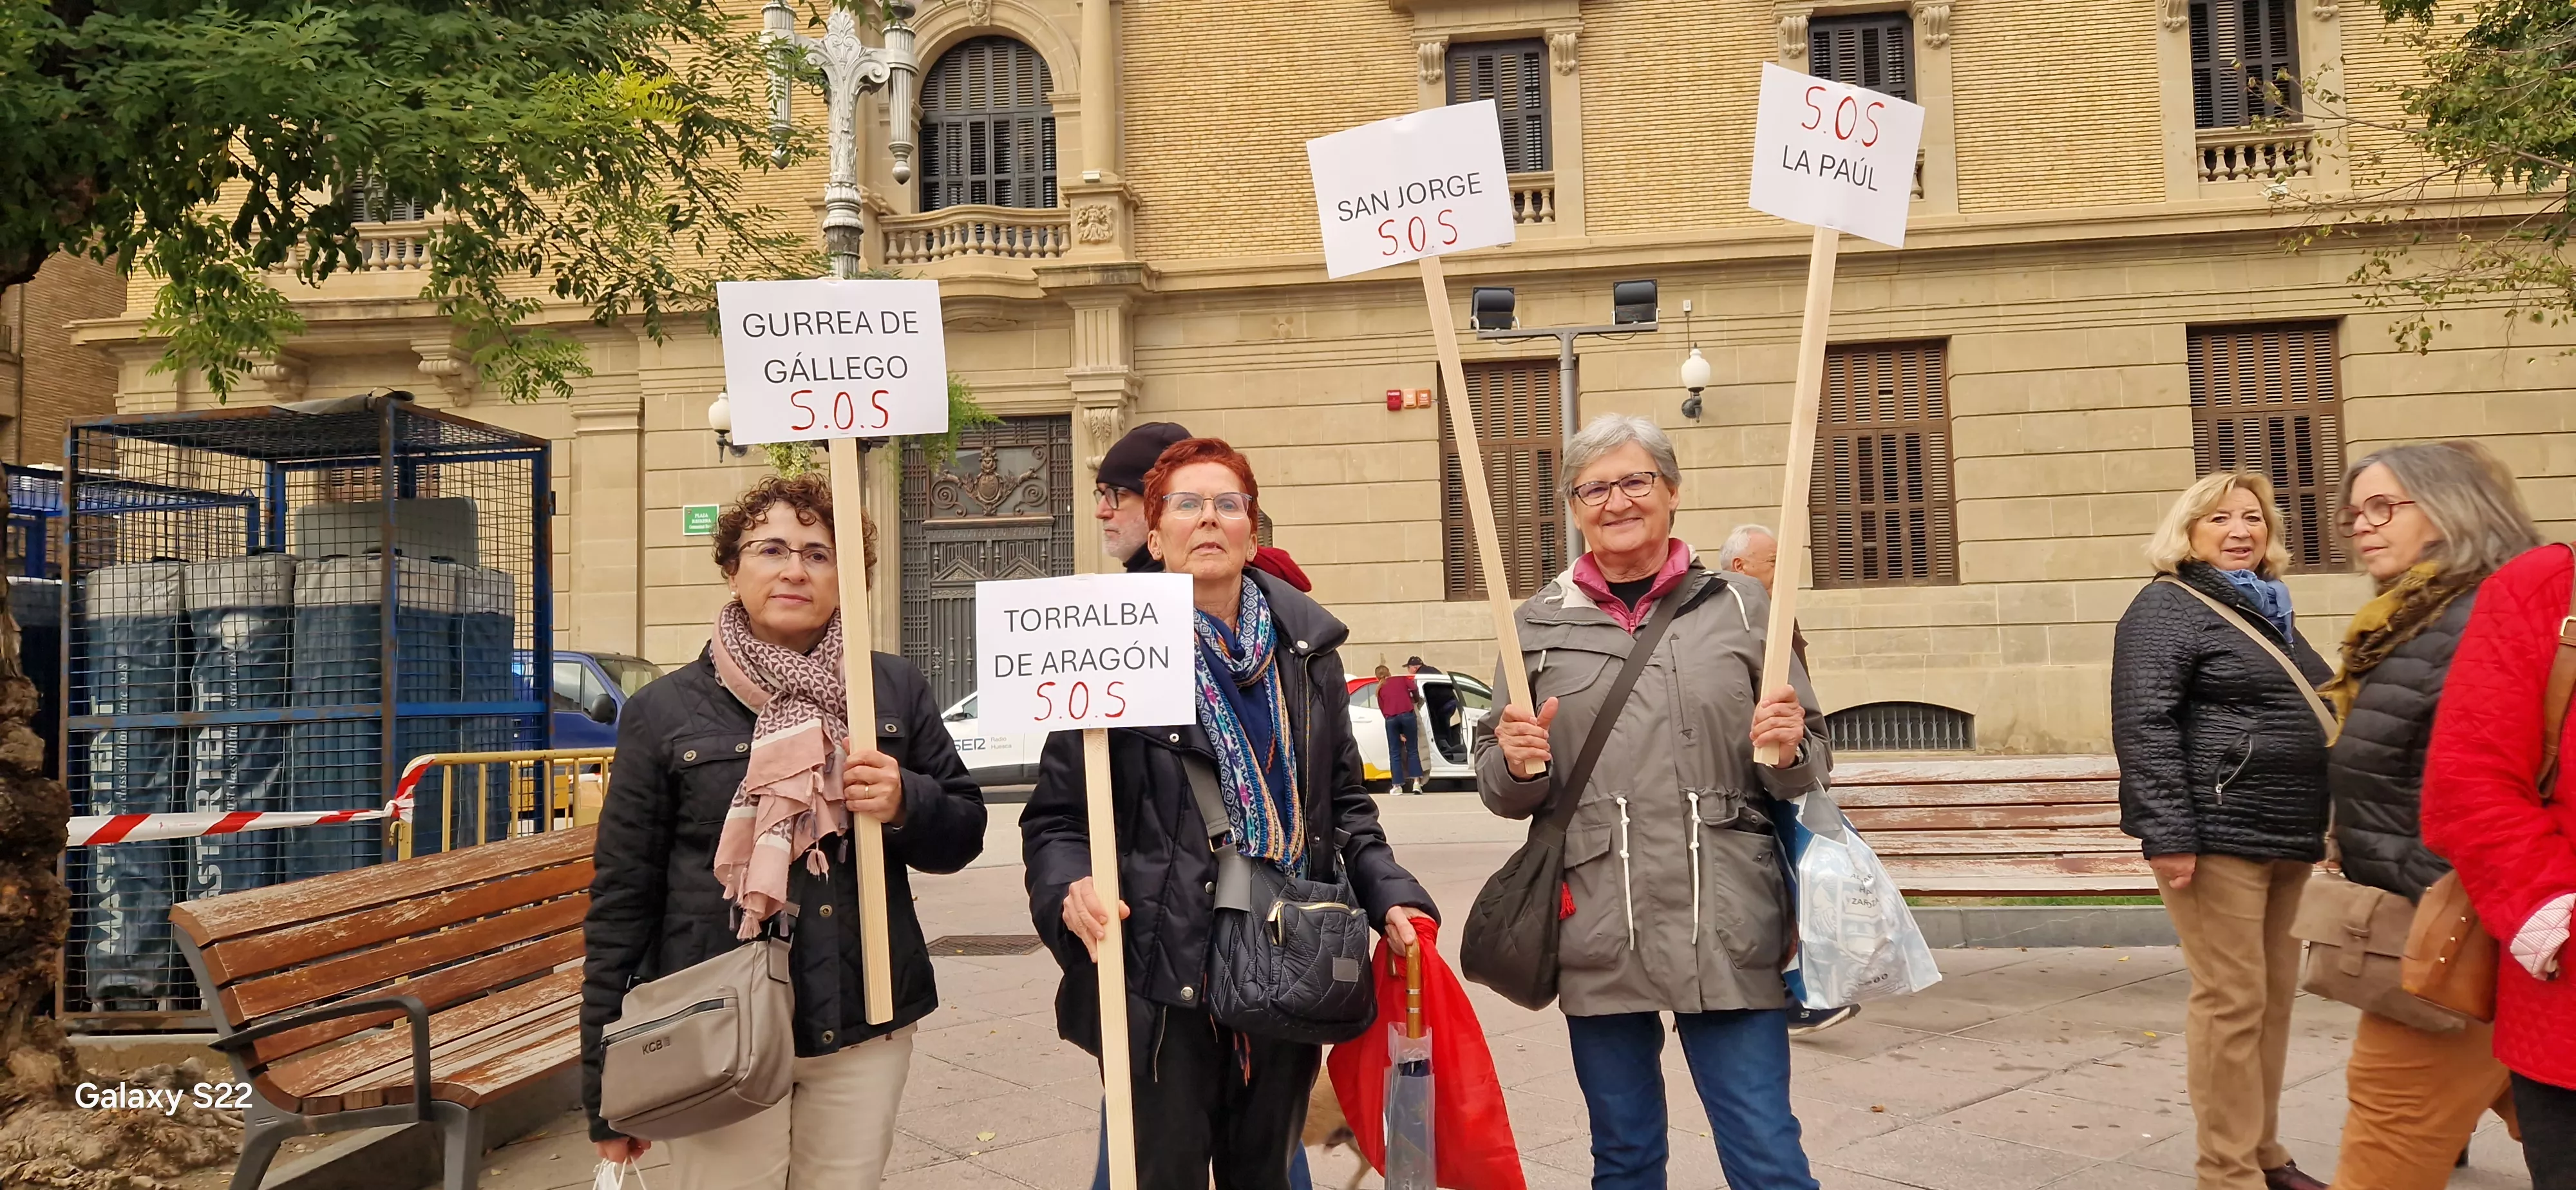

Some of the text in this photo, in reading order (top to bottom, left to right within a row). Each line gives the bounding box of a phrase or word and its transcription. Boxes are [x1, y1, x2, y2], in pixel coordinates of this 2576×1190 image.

[1801, 86, 1885, 148] S.O.S
[1783, 145, 1878, 191] LA PAÚL
[1338, 172, 1482, 222] SAN JORGE
[1378, 209, 1458, 256] S.O.S
[743, 310, 918, 338] GURREA DE
[764, 352, 908, 384] GÁLLEGO
[790, 389, 889, 431] S.O.S
[1003, 602, 1159, 632] TORRALBA
[995, 640, 1168, 677] DE ARAGÓN
[1034, 681, 1126, 721] S.O.S
[90, 695, 123, 954] MASTRTENT
[642, 1039, 663, 1055] KCB
